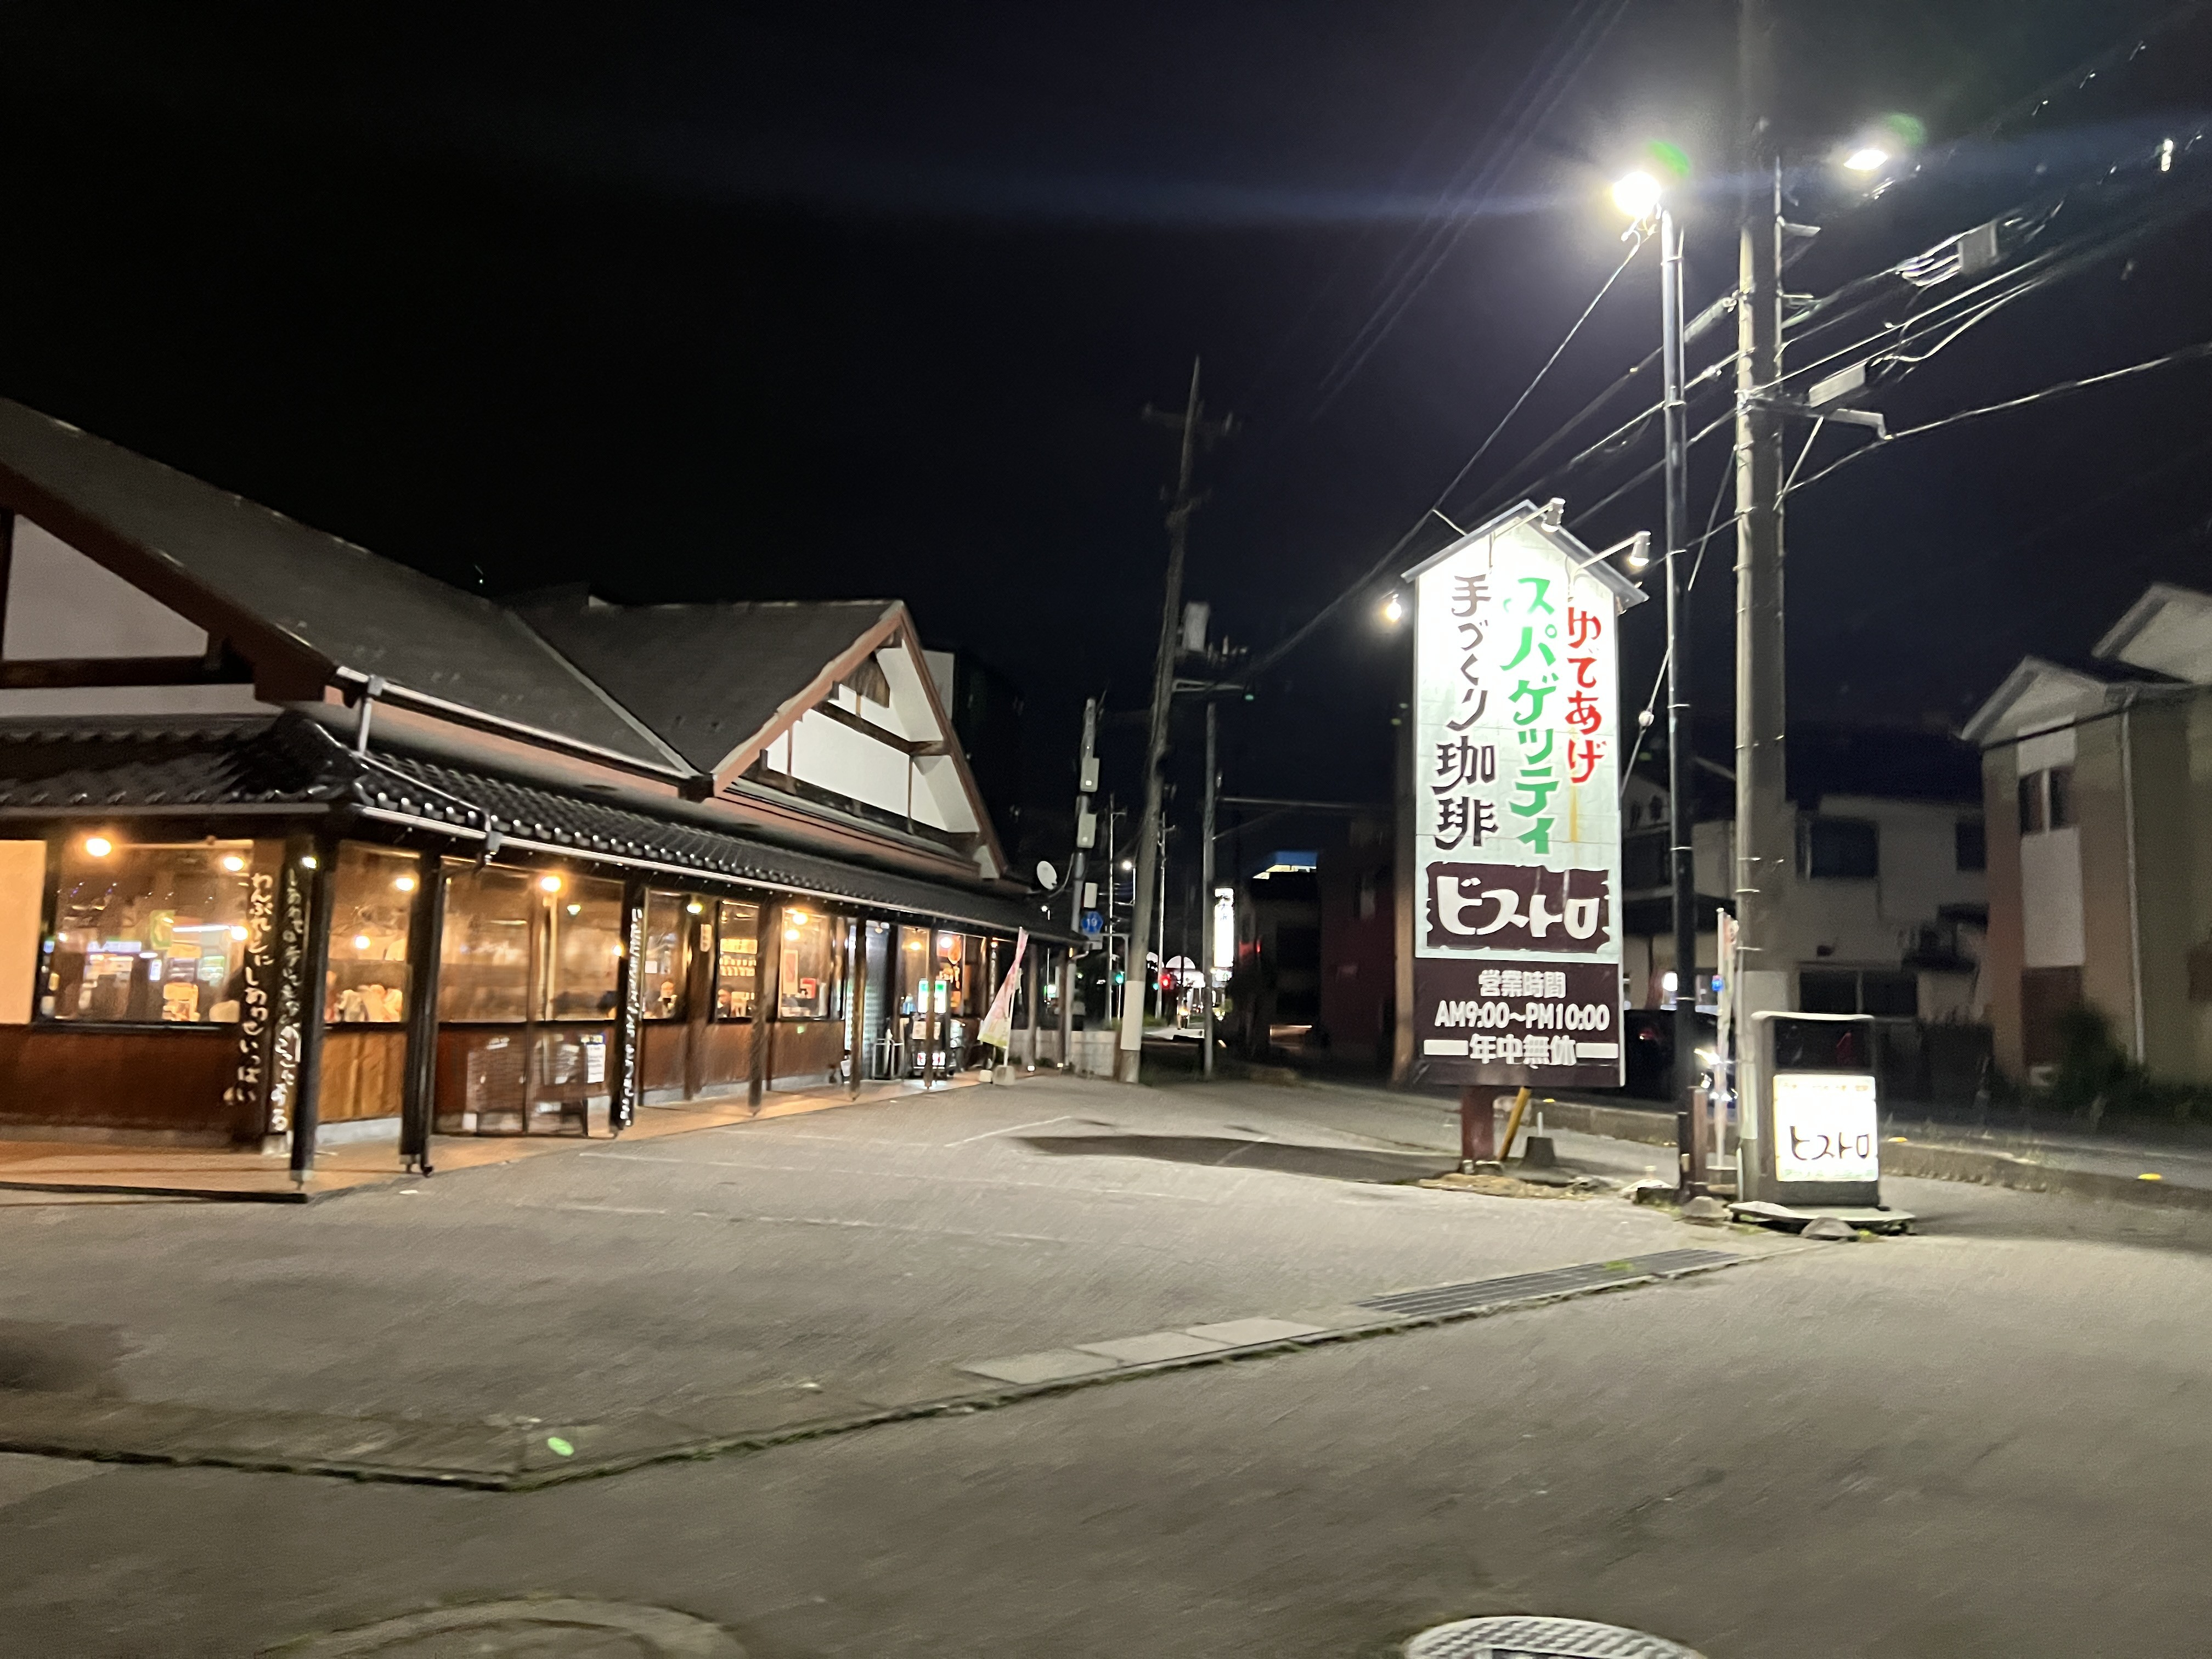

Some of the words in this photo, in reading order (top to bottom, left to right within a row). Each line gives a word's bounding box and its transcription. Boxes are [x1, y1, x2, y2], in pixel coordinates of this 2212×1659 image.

[1430, 574, 1498, 850] 手づくり珈琲
[1499, 578, 1559, 854] スパゲッティ
[1565, 607, 1607, 783] ゆであげ
[1087, 918, 1097, 931] 19
[1436, 876, 1600, 940] ビストロ
[1479, 969, 1567, 998] 営業時間
[1470, 1034, 1577, 1066] 年中無休
